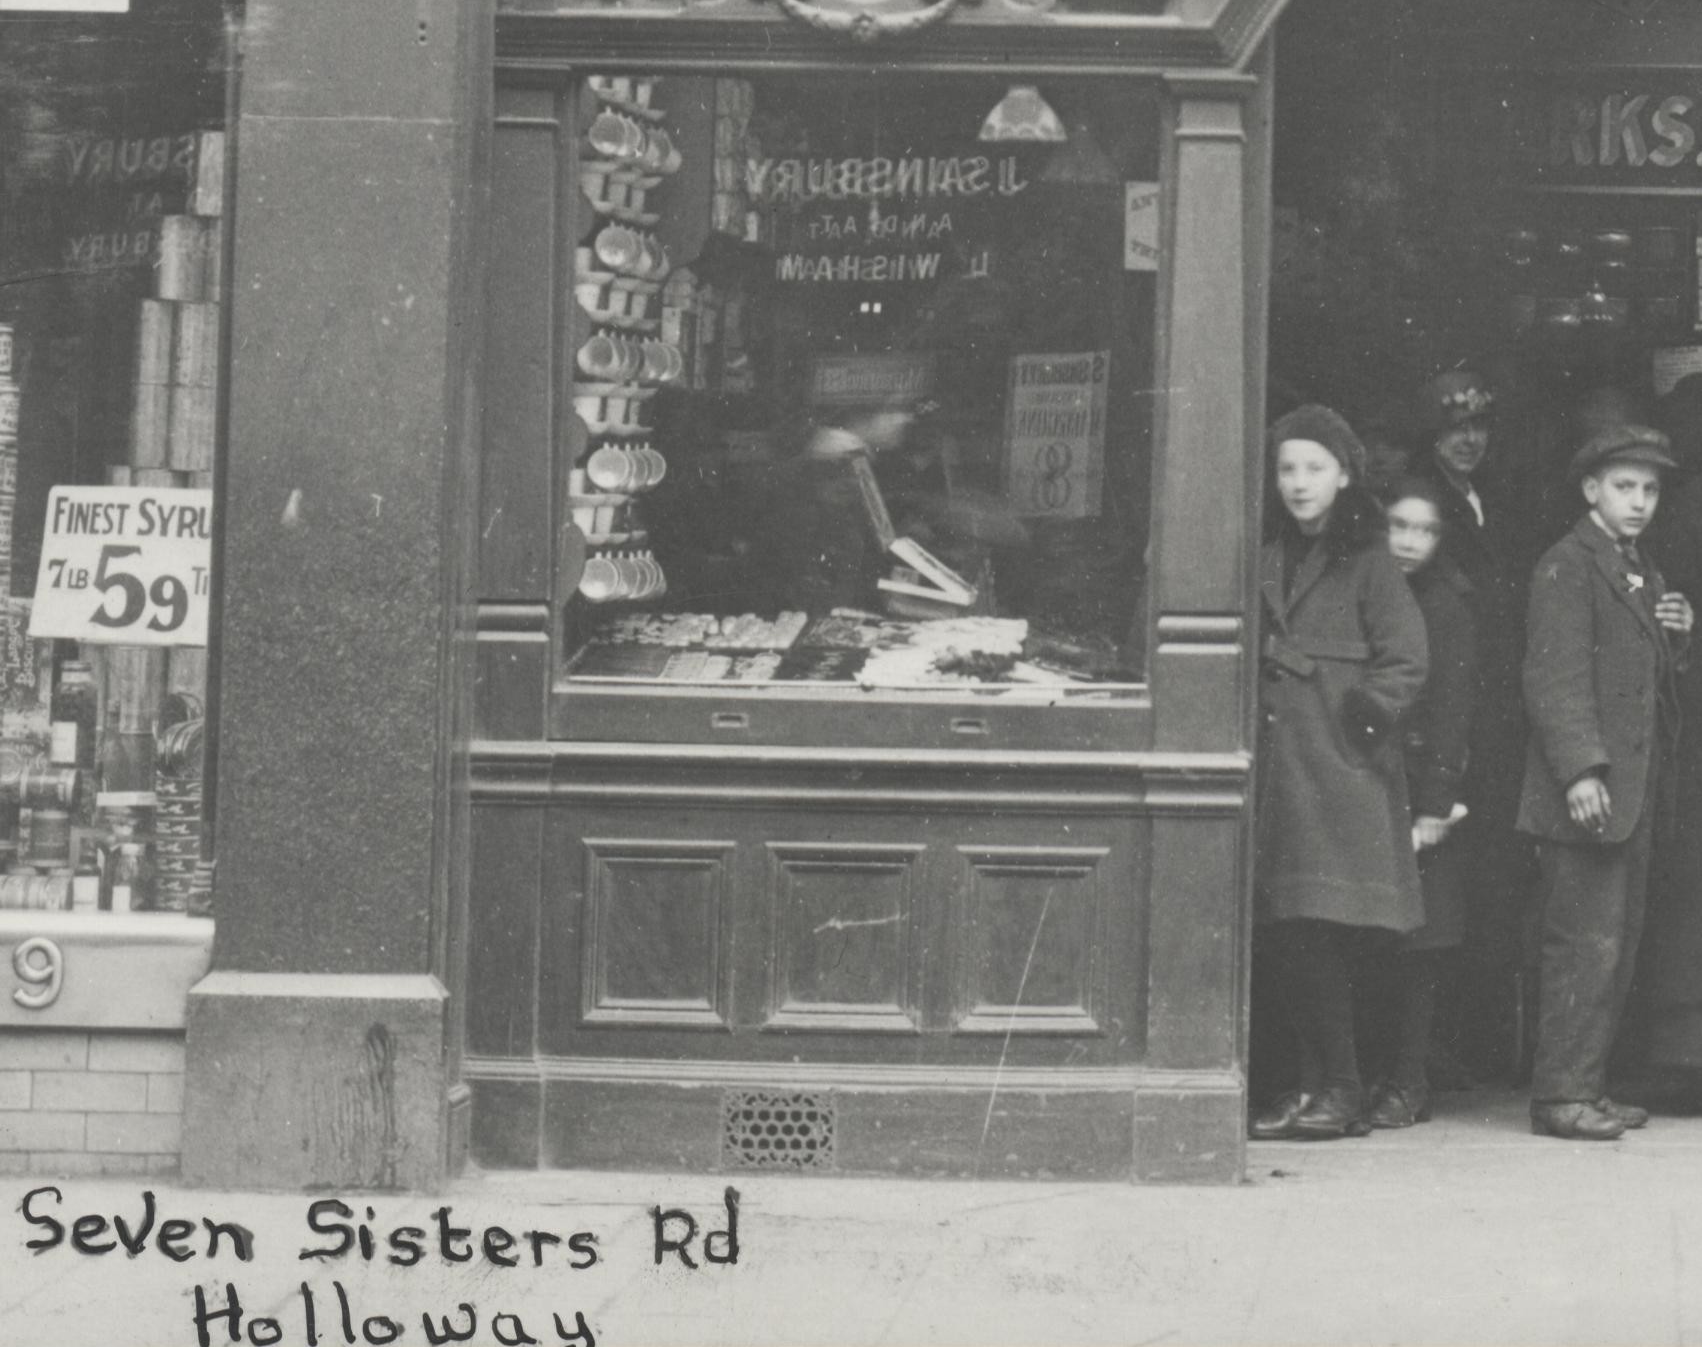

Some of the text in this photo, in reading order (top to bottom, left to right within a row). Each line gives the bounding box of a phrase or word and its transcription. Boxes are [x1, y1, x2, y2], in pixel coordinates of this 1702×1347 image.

[52, 495, 131, 536] FINEST
[47, 558, 68, 589] 7
[67, 567, 90, 590] LB
[12, 936, 63, 1010] 9
